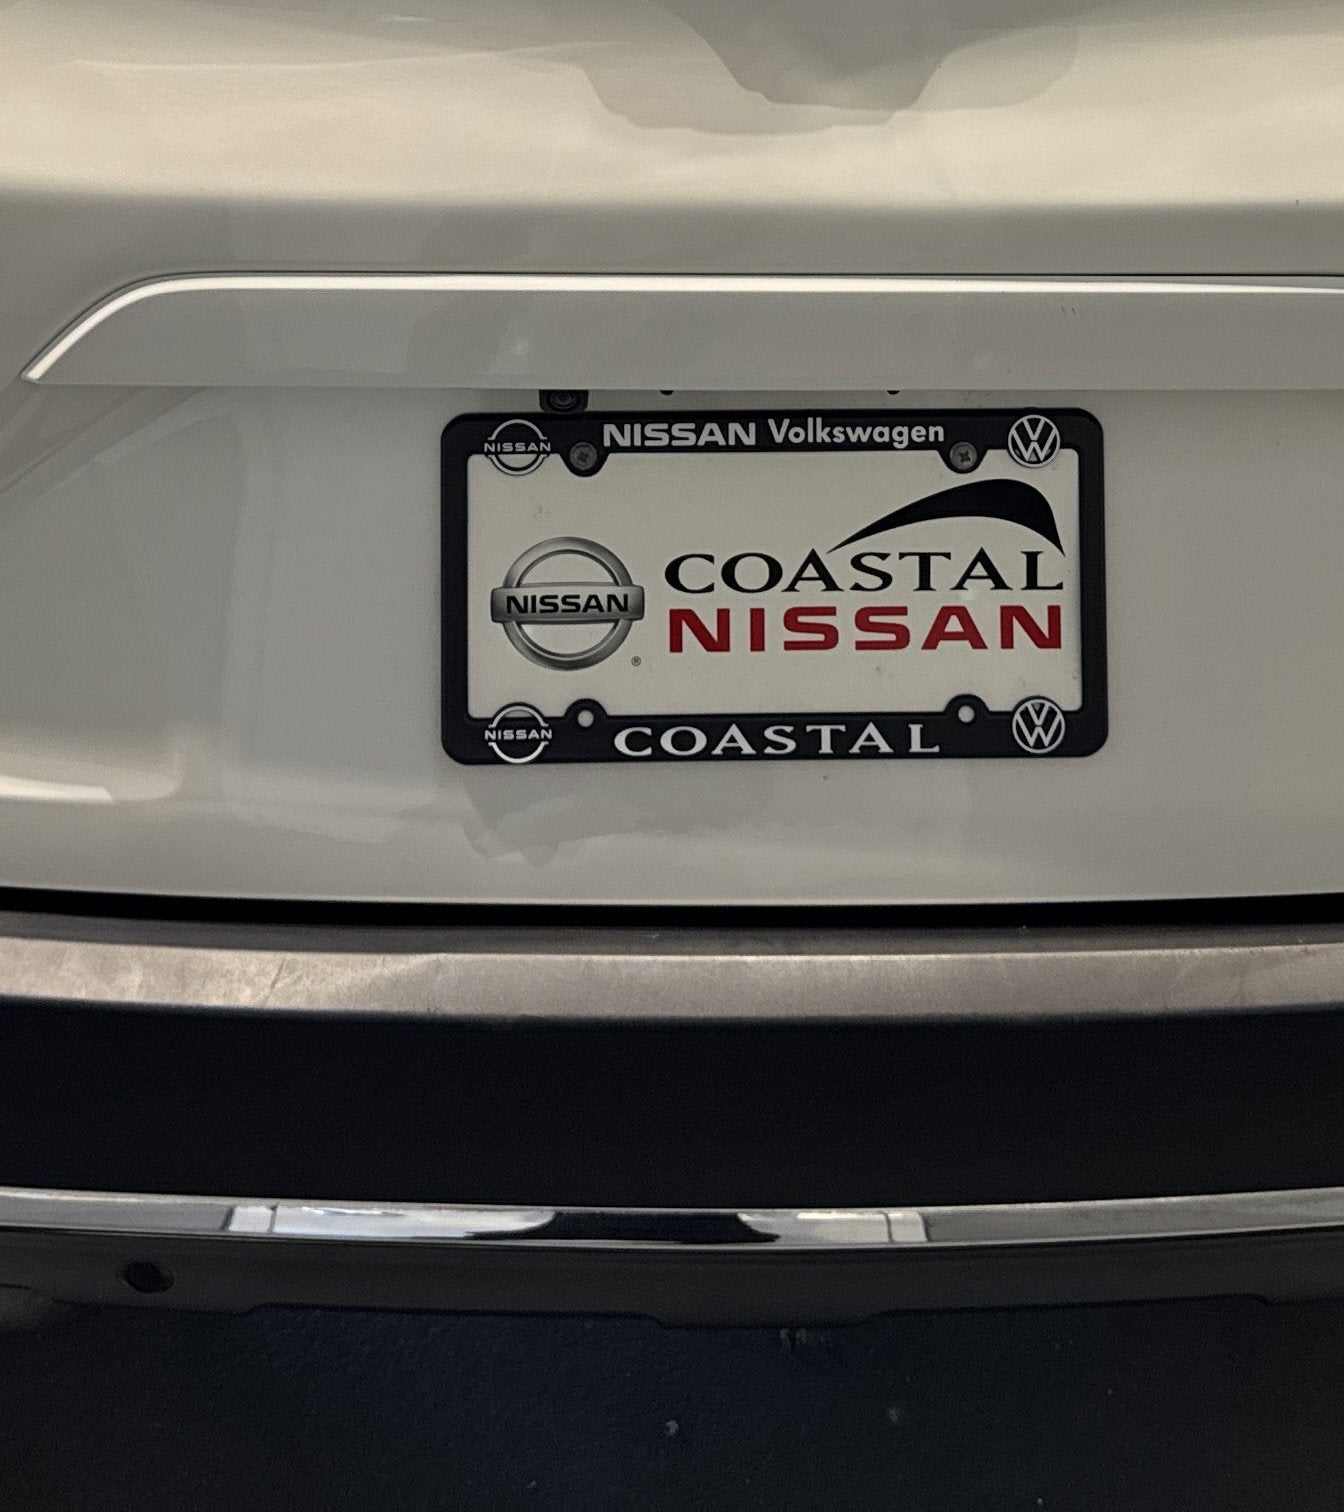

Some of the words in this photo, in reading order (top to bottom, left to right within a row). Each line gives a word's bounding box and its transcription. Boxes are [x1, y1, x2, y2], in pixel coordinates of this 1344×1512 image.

[483, 441, 551, 453] NISSAN
[602, 421, 757, 448] NISSAN
[767, 416, 945, 450] Volkswagen
[664, 546, 1064, 594] COASTAL
[505, 592, 630, 615] NISSAN
[668, 604, 1062, 654] NISSAN
[484, 727, 553, 741] NISSAN
[613, 721, 941, 757] COASTAL
